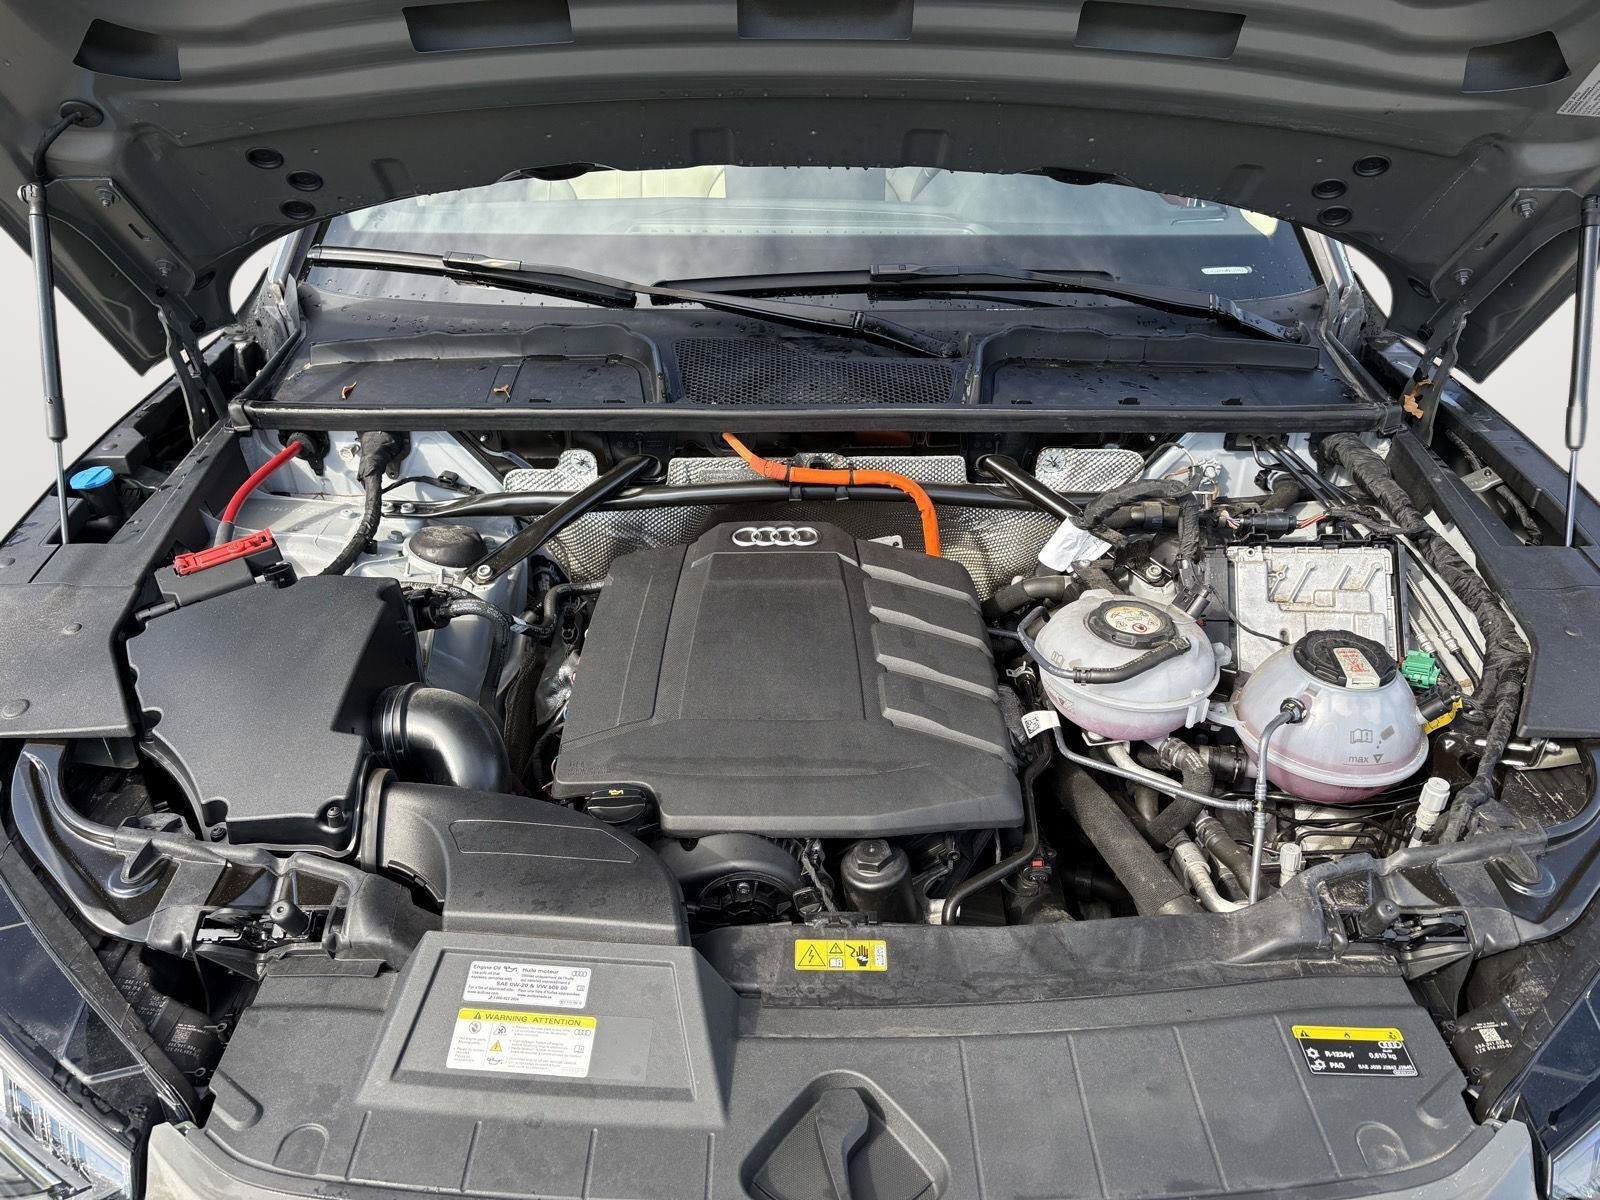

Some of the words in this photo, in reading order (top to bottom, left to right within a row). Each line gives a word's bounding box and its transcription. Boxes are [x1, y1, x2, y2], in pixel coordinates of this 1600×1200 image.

[485, 1013, 528, 1023] WARNING
[532, 1018, 582, 1027] ATTENTION
[1324, 1050, 1355, 1059] R-1234yf
[1387, 1053, 1398, 1061] kg
